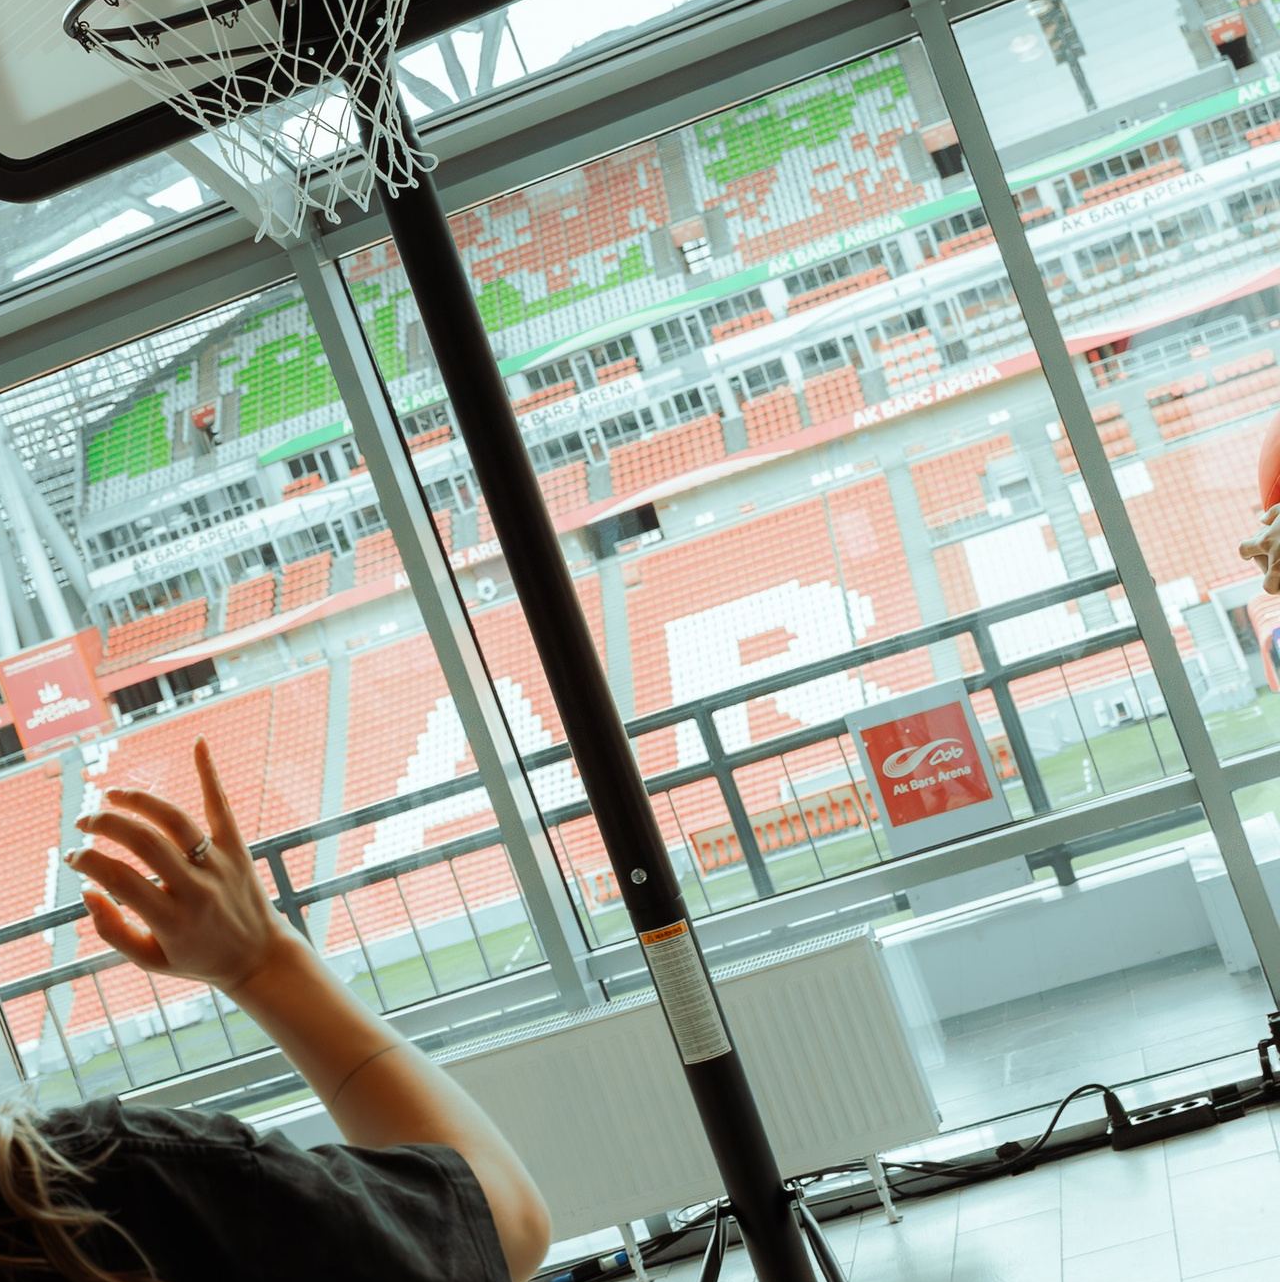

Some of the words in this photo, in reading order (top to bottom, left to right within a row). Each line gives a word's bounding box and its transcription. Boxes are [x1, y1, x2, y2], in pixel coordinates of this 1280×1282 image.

[792, 235, 842, 266] BARS
[843, 214, 905, 249] ARENA
[531, 400, 574, 425] BARS
[580, 380, 634, 407] ARENA
[880, 388, 933, 419] БАРС
[935, 364, 1002, 400] АРЕНА
[155, 539, 194, 564] БАРС
[199, 520, 250, 545] АРЕНА
[893, 782, 910, 797] Ak
[909, 775, 936, 791] Bars
[938, 766, 972, 783] Arena
